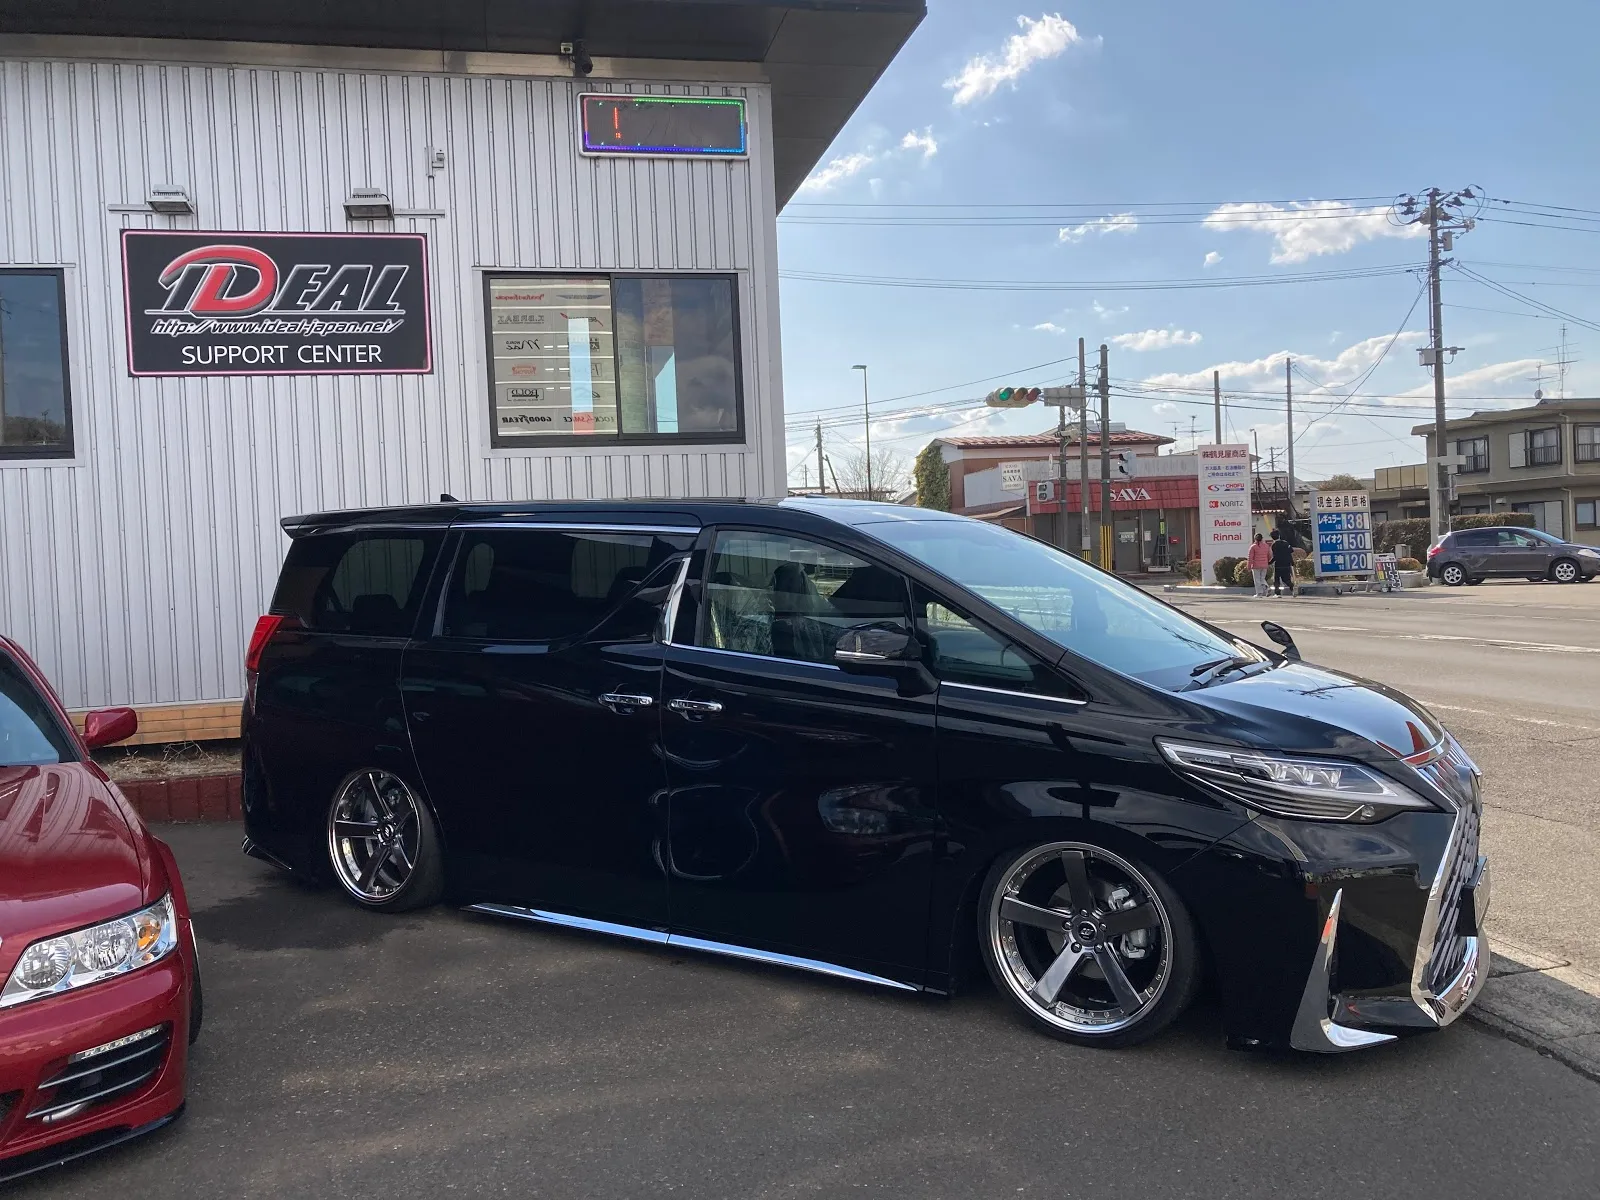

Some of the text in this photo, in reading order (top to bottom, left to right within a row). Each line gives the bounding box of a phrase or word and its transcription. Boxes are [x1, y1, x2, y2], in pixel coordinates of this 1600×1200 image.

[158, 244, 409, 318] IDEAL
[182, 344, 383, 365] SUPPORT CENTER
[1002, 475, 1023, 483] SAVA
[1109, 487, 1152, 502] SAVA
[1220, 500, 1244, 508] NORITZ
[1317, 495, 1367, 508] 現金会員価格
[1318, 514, 1342, 524] レギュラー
[1213, 532, 1242, 542] Rinnai
[1320, 534, 1343, 544] ハイオク
